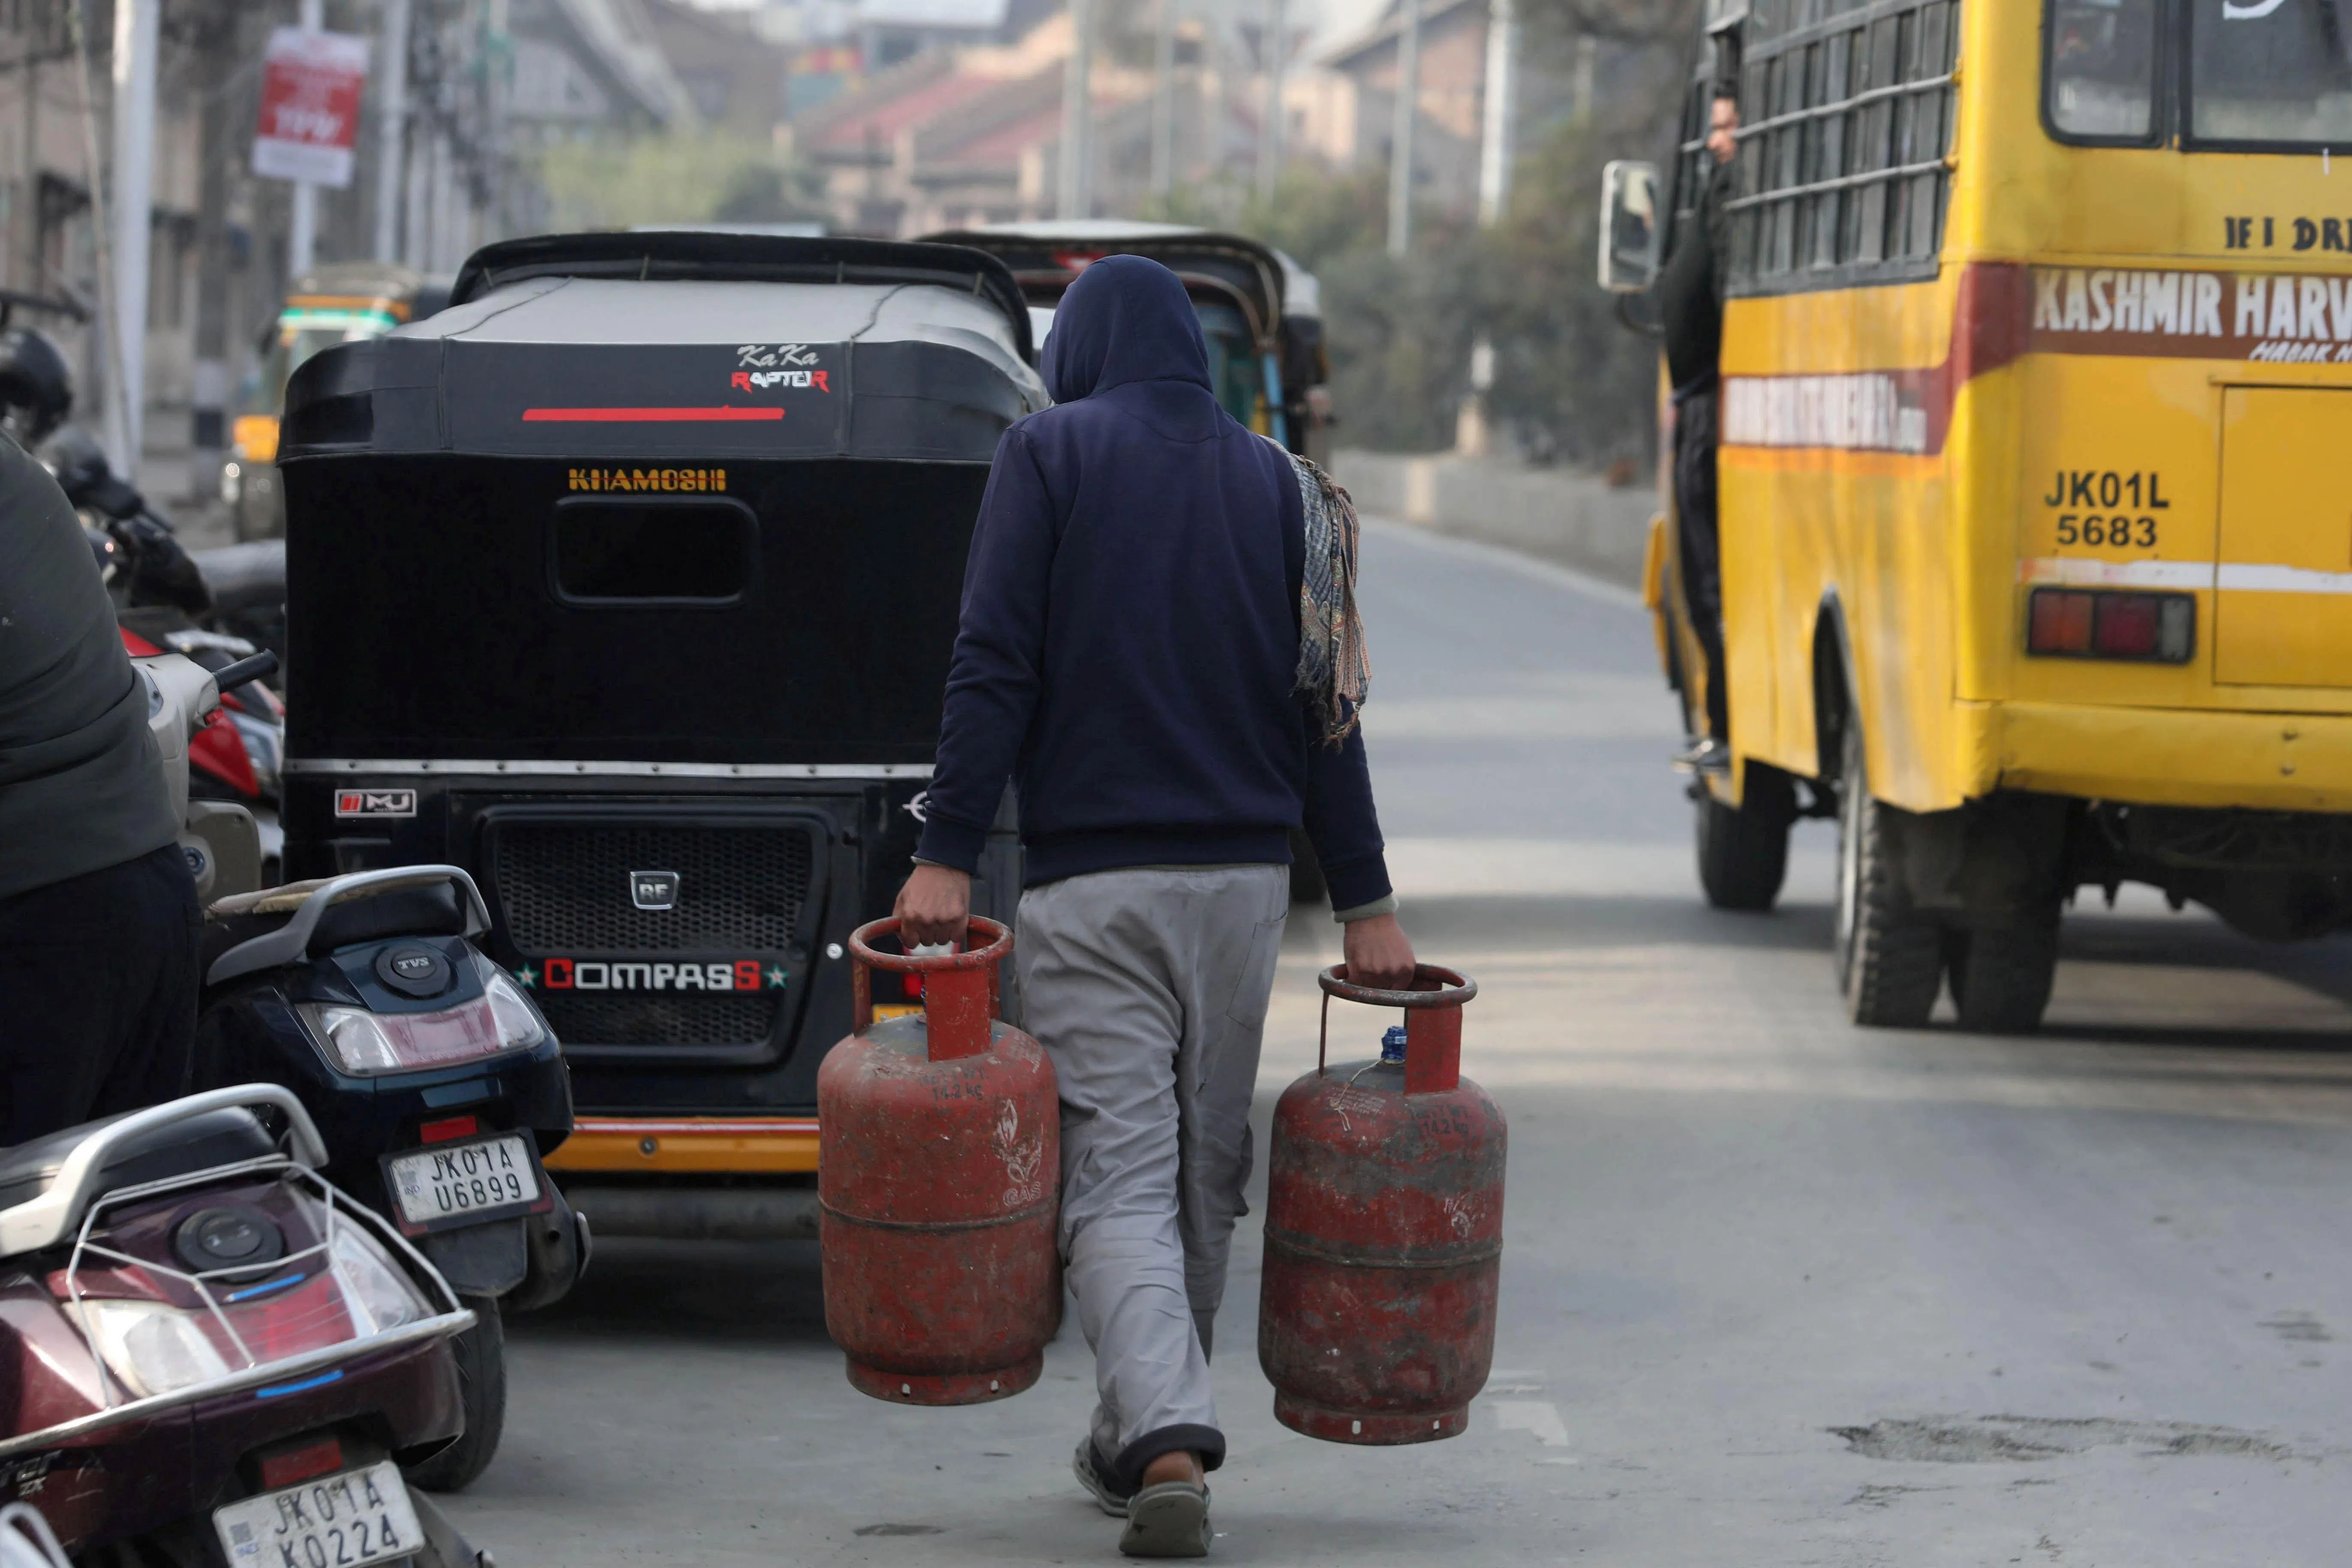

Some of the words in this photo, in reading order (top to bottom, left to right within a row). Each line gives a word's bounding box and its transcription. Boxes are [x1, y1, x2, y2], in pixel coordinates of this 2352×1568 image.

[2224, 215, 2253, 250] IF
[2263, 215, 2274, 248] I
[2033, 270, 2223, 338] KASHMIR
[568, 469, 726, 491] KHAMOSHI
[2044, 471, 2170, 509] JK01L
[2057, 515, 2157, 548] 5683
[638, 883, 669, 900] RE
[397, 957, 430, 970] TVS
[544, 958, 761, 990] COMPASS
[431, 1142, 513, 1181] JK01A
[435, 1173, 521, 1212] U6899
[274, 1472, 385, 1534] JK01A
[279, 1513, 400, 1568] K0224
